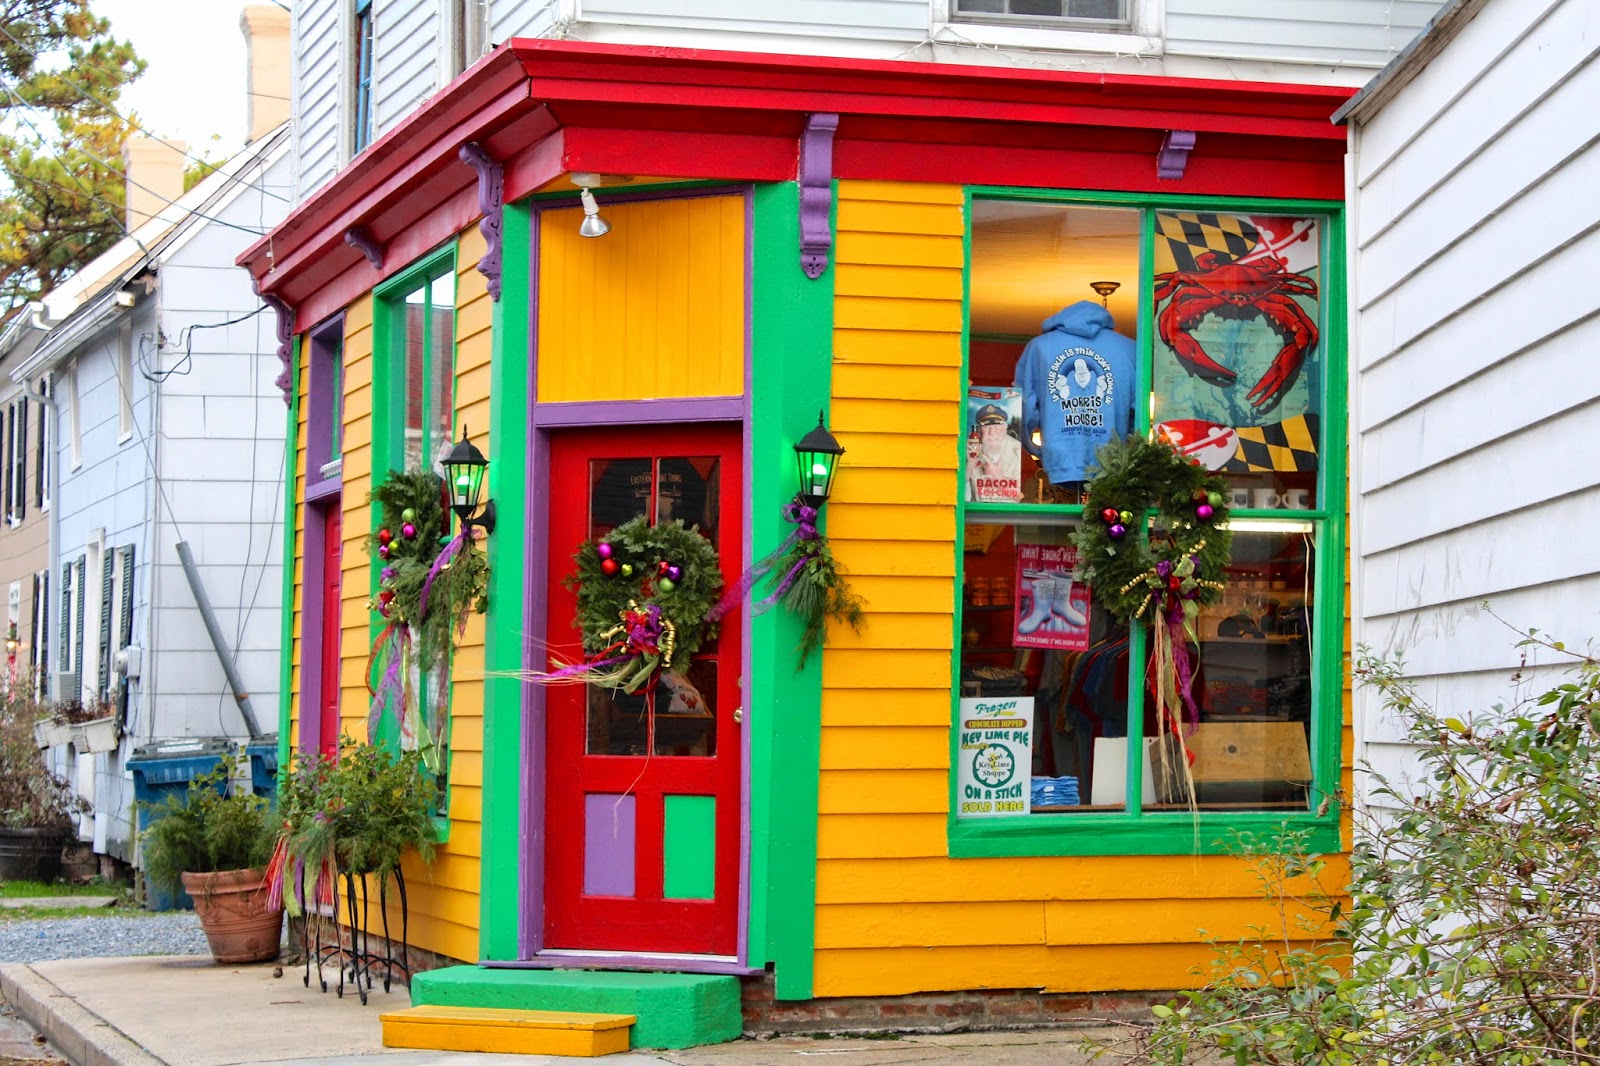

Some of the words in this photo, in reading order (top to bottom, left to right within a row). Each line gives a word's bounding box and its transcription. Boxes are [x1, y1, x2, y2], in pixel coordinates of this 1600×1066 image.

[976, 479, 1017, 488] BACON
[975, 701, 1017, 717] Frozen
[968, 720, 1000, 728] CHOCOLATE
[1001, 719, 1024, 727] DIPPED
[962, 731, 982, 745] KEY
[985, 731, 1010, 740] LIME
[1013, 731, 1029, 747] PIE
[987, 754, 1003, 763] West
[978, 761, 991, 769] Key
[982, 769, 1006, 777] Shoppe
[964, 784, 981, 800] ON
[985, 789, 992, 800] A
[995, 781, 1023, 800] STICK
[961, 801, 993, 814] SOLD
[994, 801, 1024, 812] HERE
